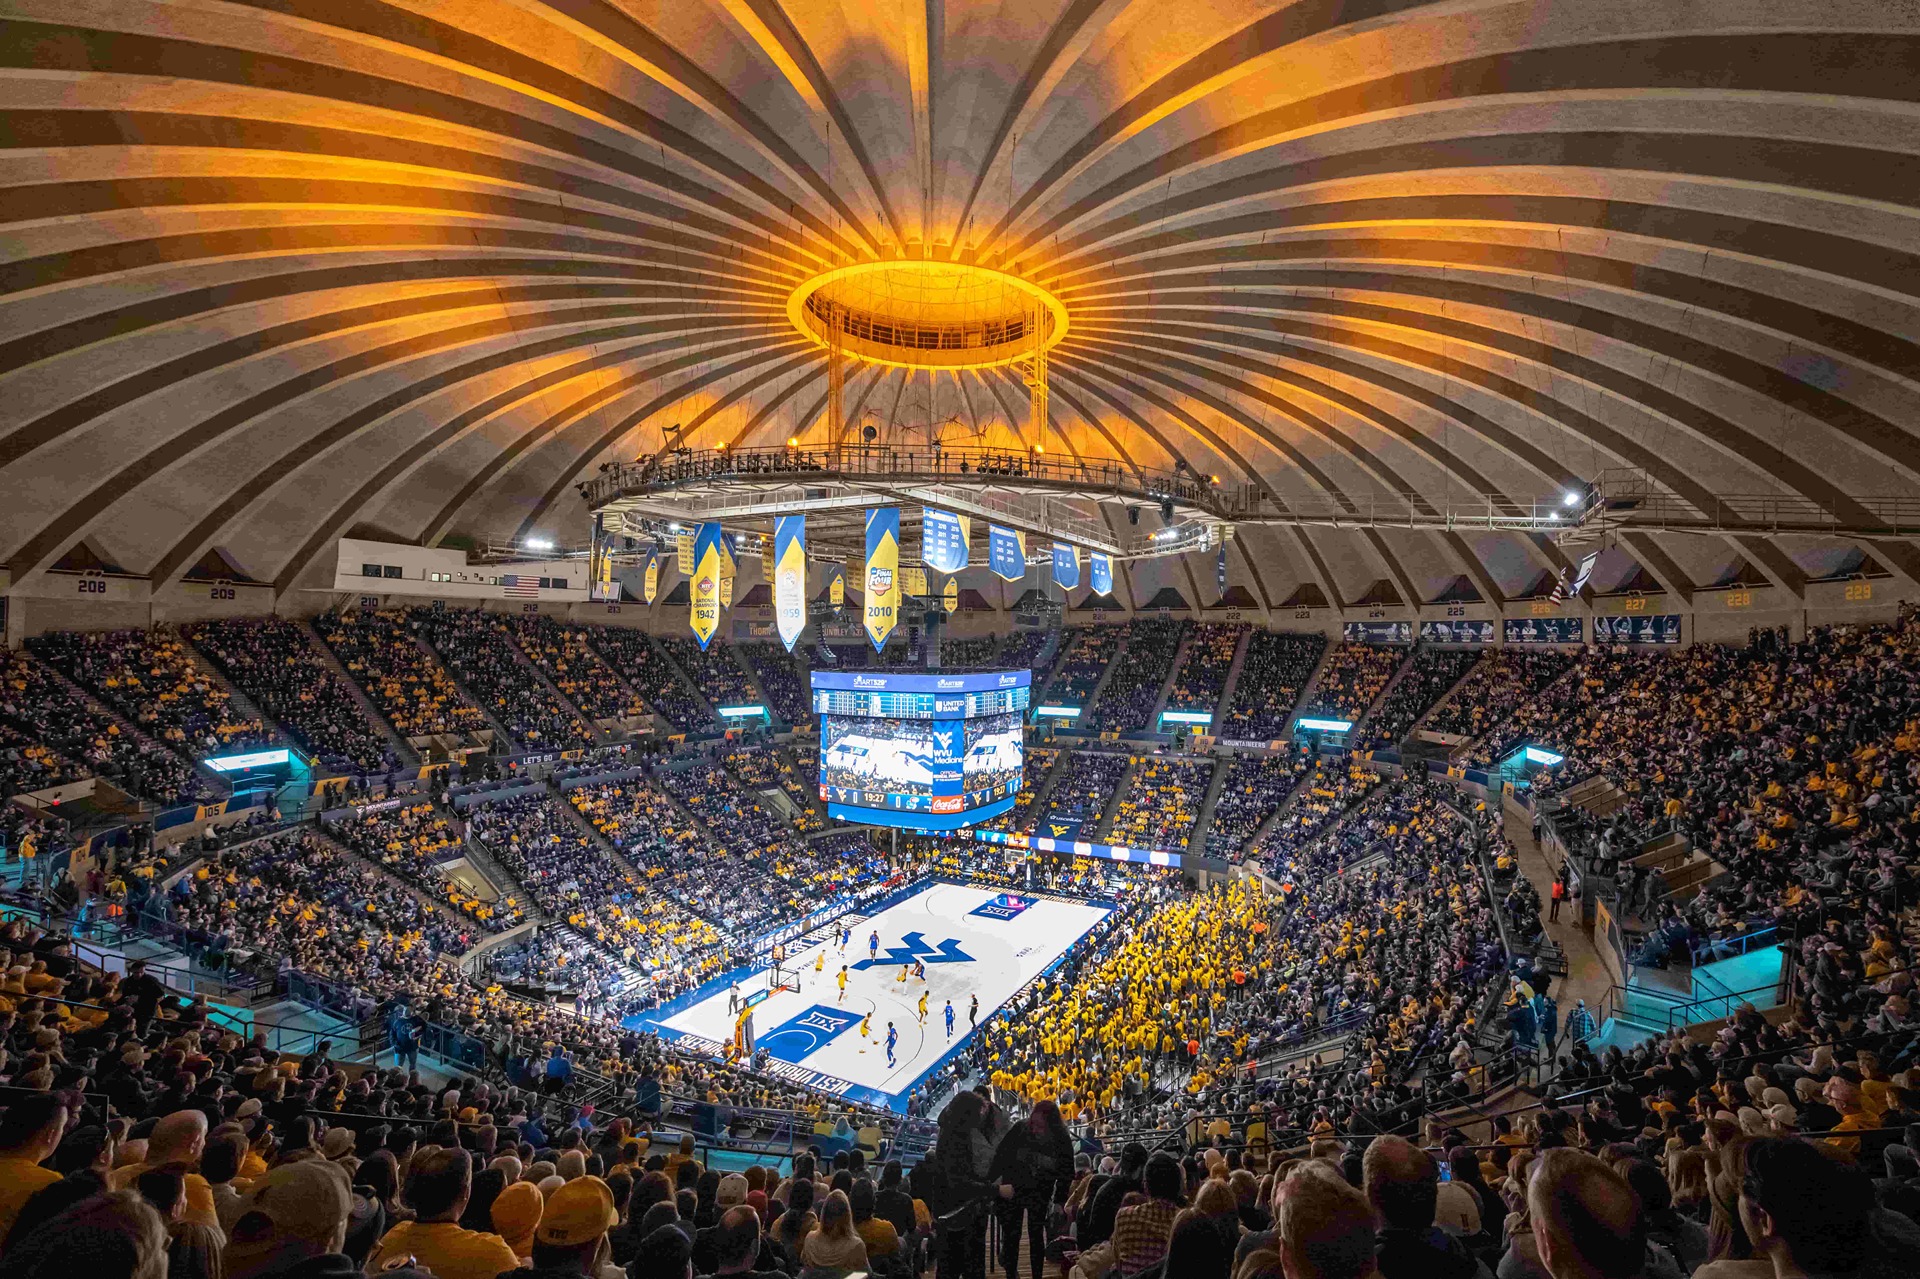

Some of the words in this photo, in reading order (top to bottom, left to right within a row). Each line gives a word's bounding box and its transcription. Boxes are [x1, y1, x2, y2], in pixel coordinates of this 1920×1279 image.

[78, 580, 106, 593] 208
[211, 588, 236, 600] 209
[1845, 584, 1872, 600] 229
[361, 597, 378, 607] 210
[1727, 592, 1750, 606] 228
[523, 604, 538, 612] 212
[1532, 604, 1550, 614] 226
[1626, 599, 1646, 610] 227
[696, 610, 714, 619] 1942
[868, 606, 892, 617] 2010
[1226, 612, 1241, 620] 222
[1295, 611, 1310, 619] 223
[1448, 606, 1464, 616] 225
[823, 628, 848, 636] UNDLEY
[1222, 740, 1266, 748] MOUNTAINEERS
[523, 756, 542, 764] LET'S
[994, 786, 1006, 796] 19:27
[853, 792, 858, 804] 0
[864, 792, 884, 802] 19:27
[896, 796, 900, 808] 0
[204, 806, 220, 818] 105
[957, 829, 973, 837] 19:27
[810, 900, 854, 928] NISSAN
[755, 924, 803, 953] NISSAN
[809, 1076, 854, 1096] WEST
